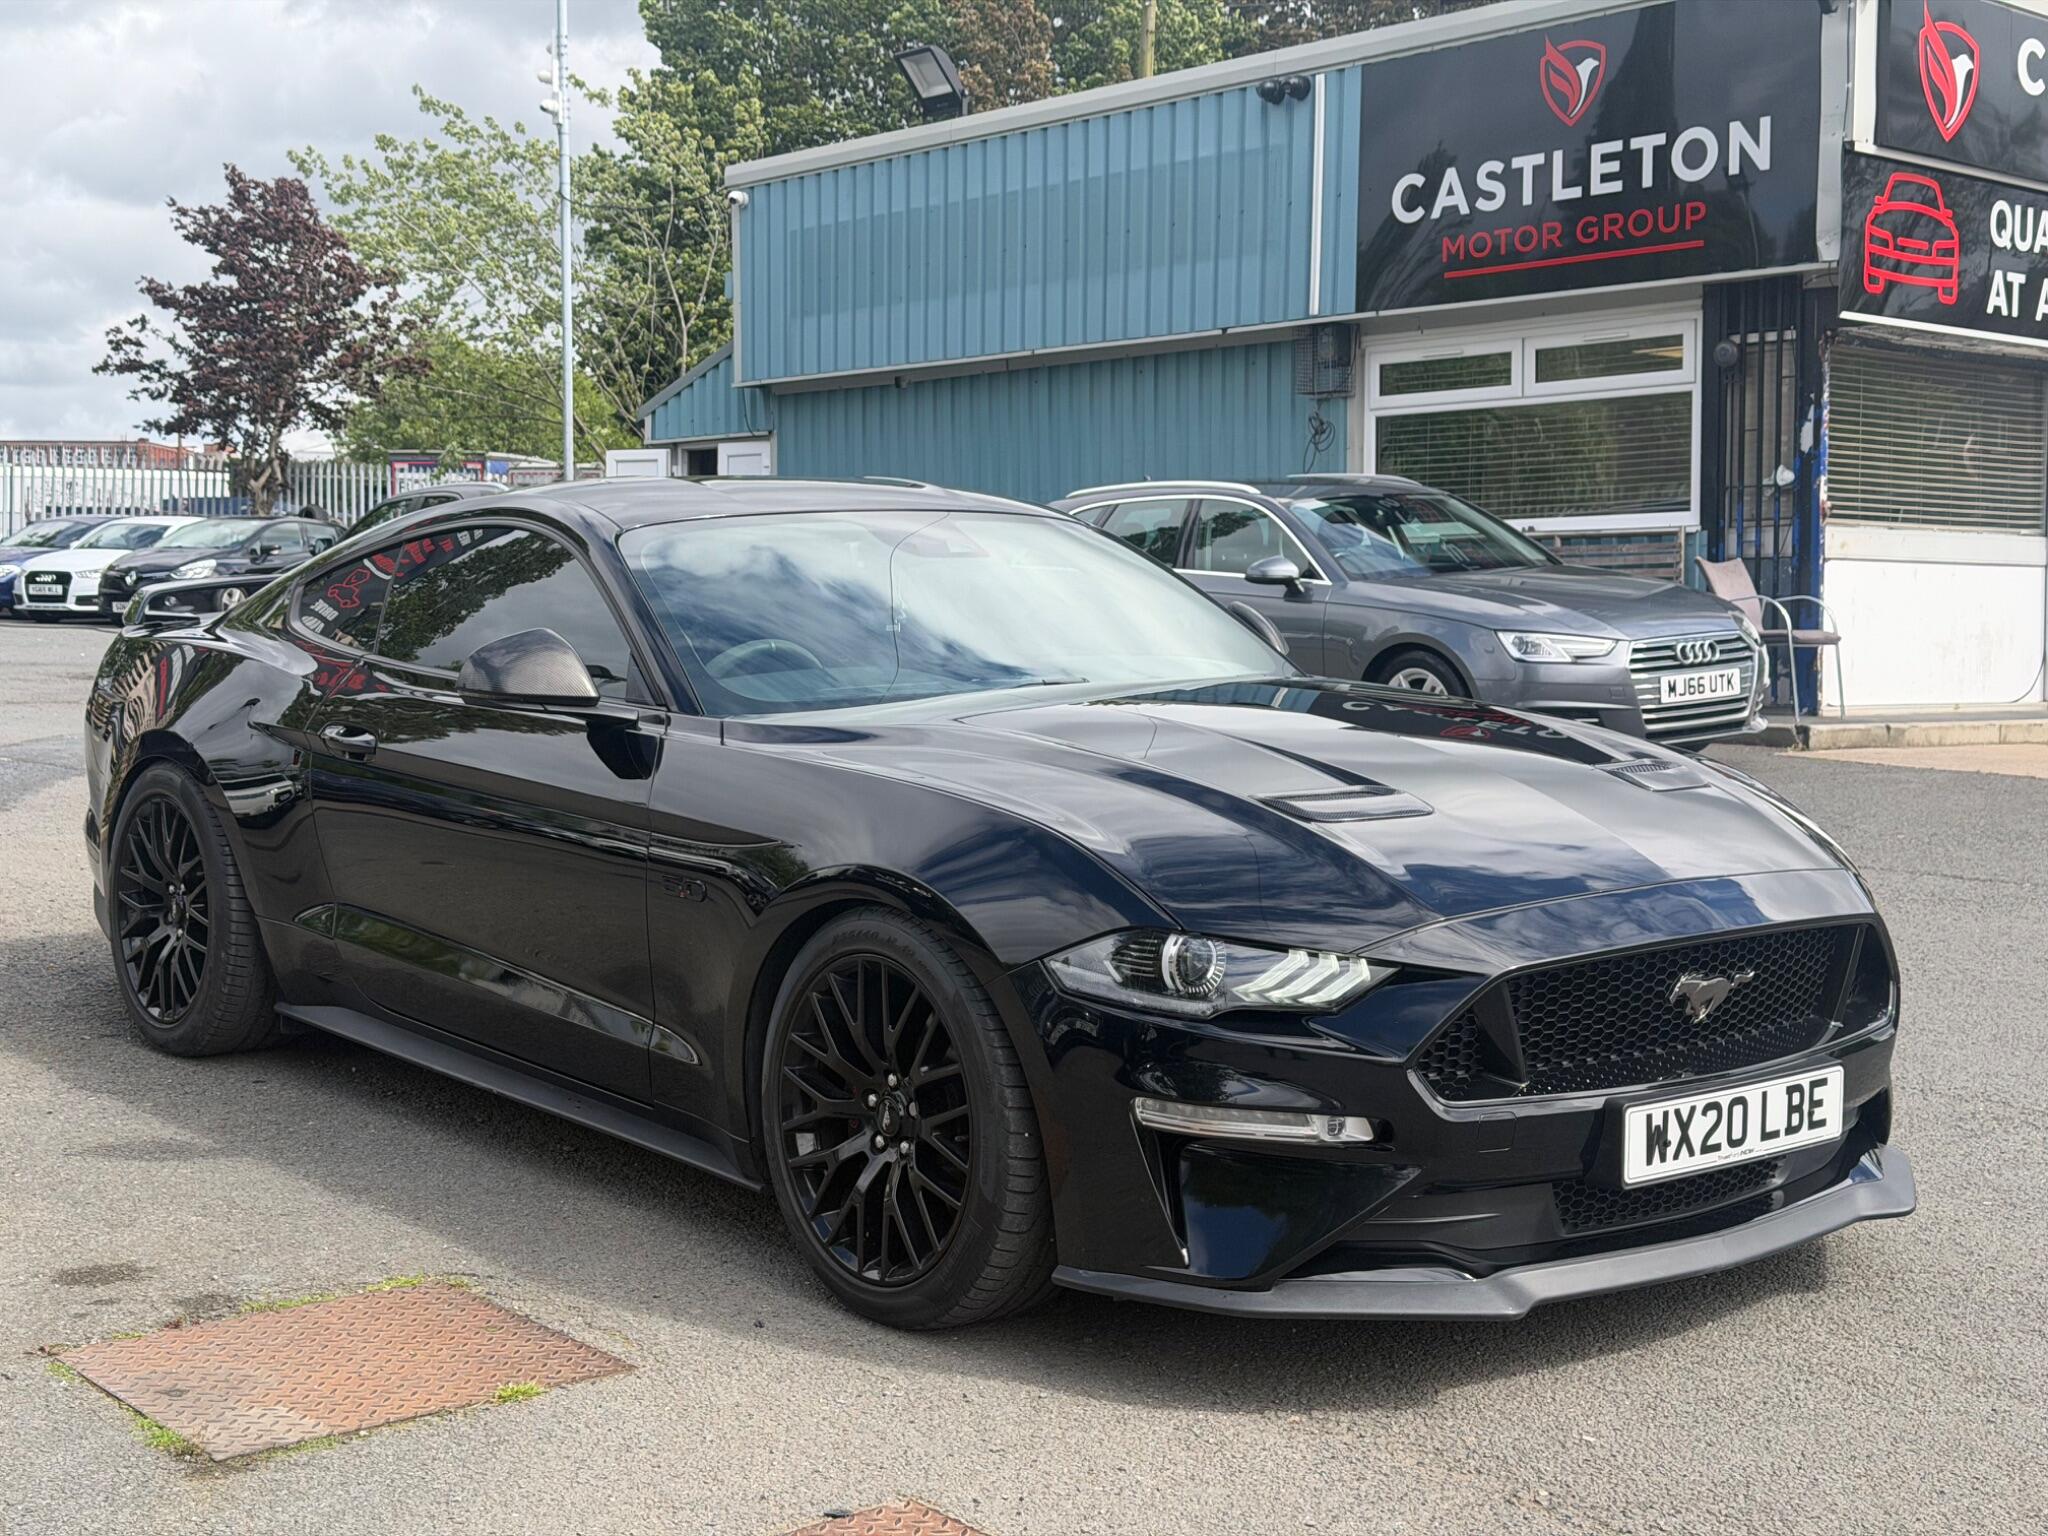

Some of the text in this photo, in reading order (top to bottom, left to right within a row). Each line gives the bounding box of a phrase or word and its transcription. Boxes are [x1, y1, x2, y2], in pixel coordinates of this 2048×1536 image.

[1391, 115, 1772, 225] CASTLETON
[1441, 201, 1708, 263] MOTOR GROUP
[1986, 269, 2027, 318] AT
[1668, 673, 1735, 699] MJ66 UTK
[1645, 1077, 1829, 1167] WX20 LBE
